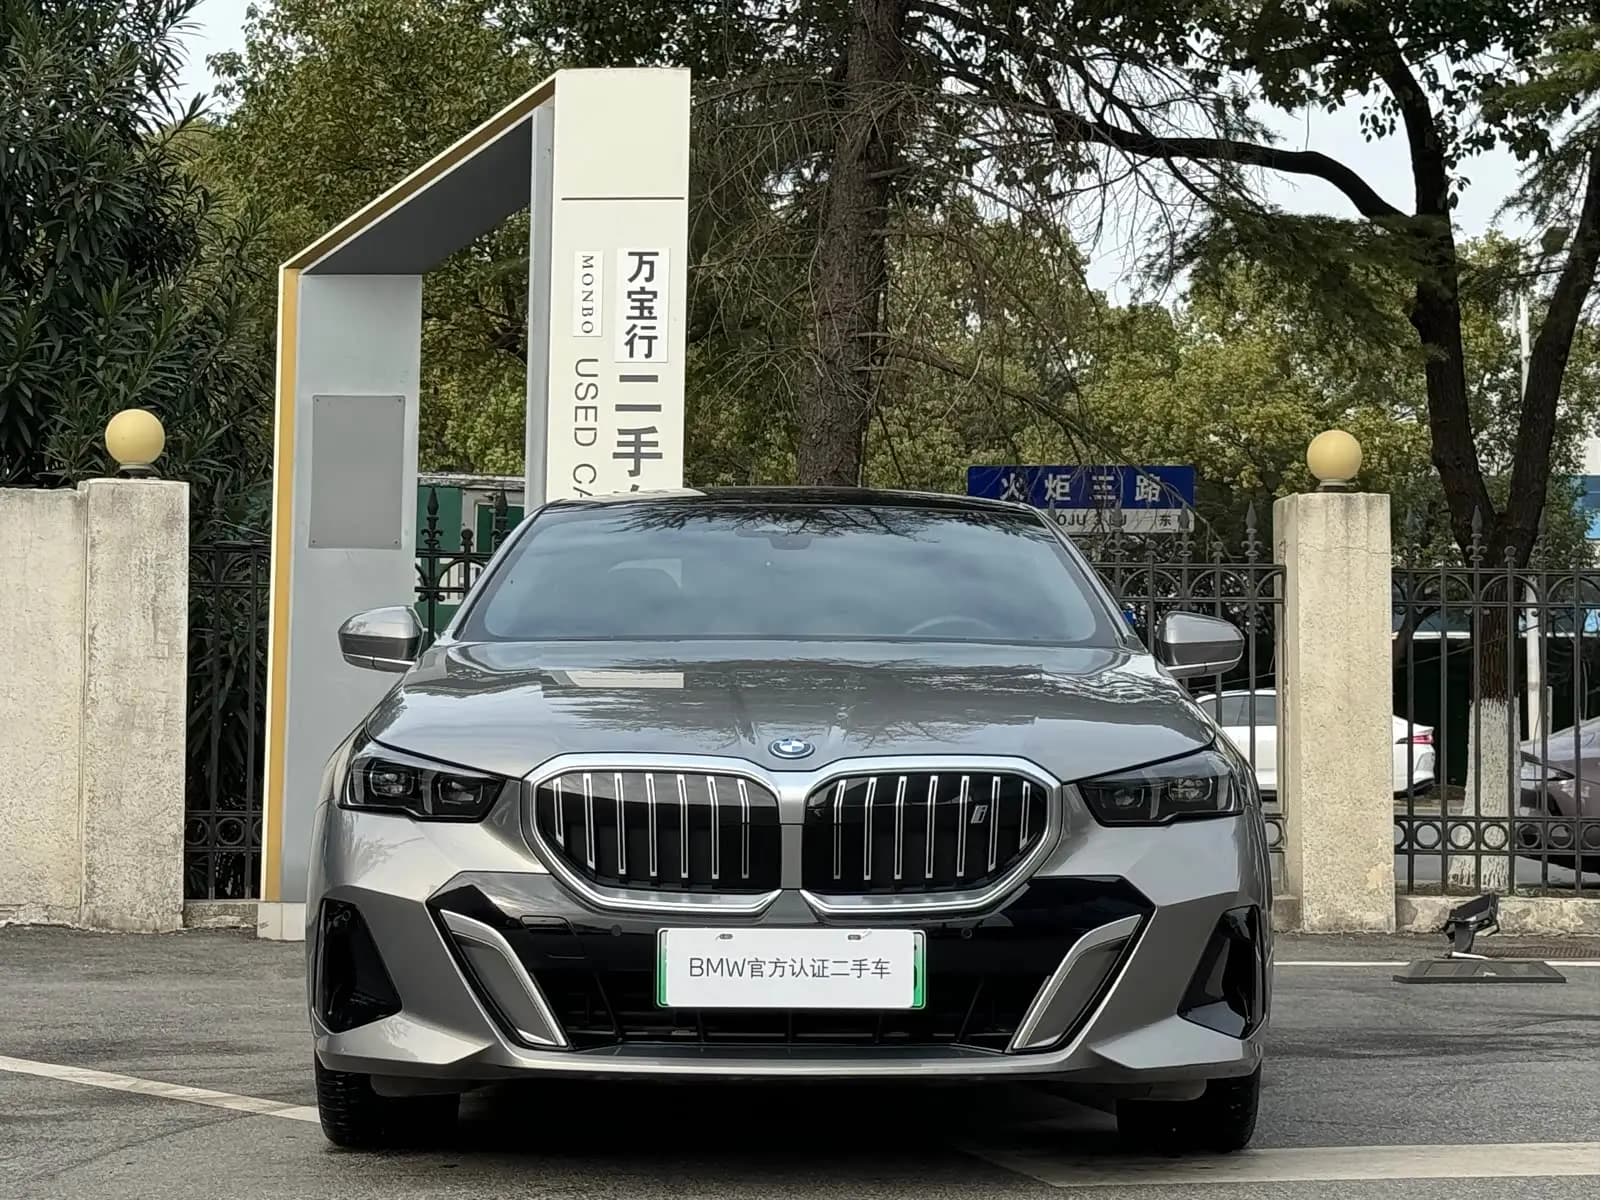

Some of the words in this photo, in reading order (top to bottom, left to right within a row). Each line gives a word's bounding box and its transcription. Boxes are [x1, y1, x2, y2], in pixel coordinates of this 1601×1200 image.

[580, 254, 595, 334] MONBO
[573, 357, 599, 447] USED
[999, 472, 1161, 502] 火炬三路
[688, 957, 891, 979] BMW官方认证二手车
